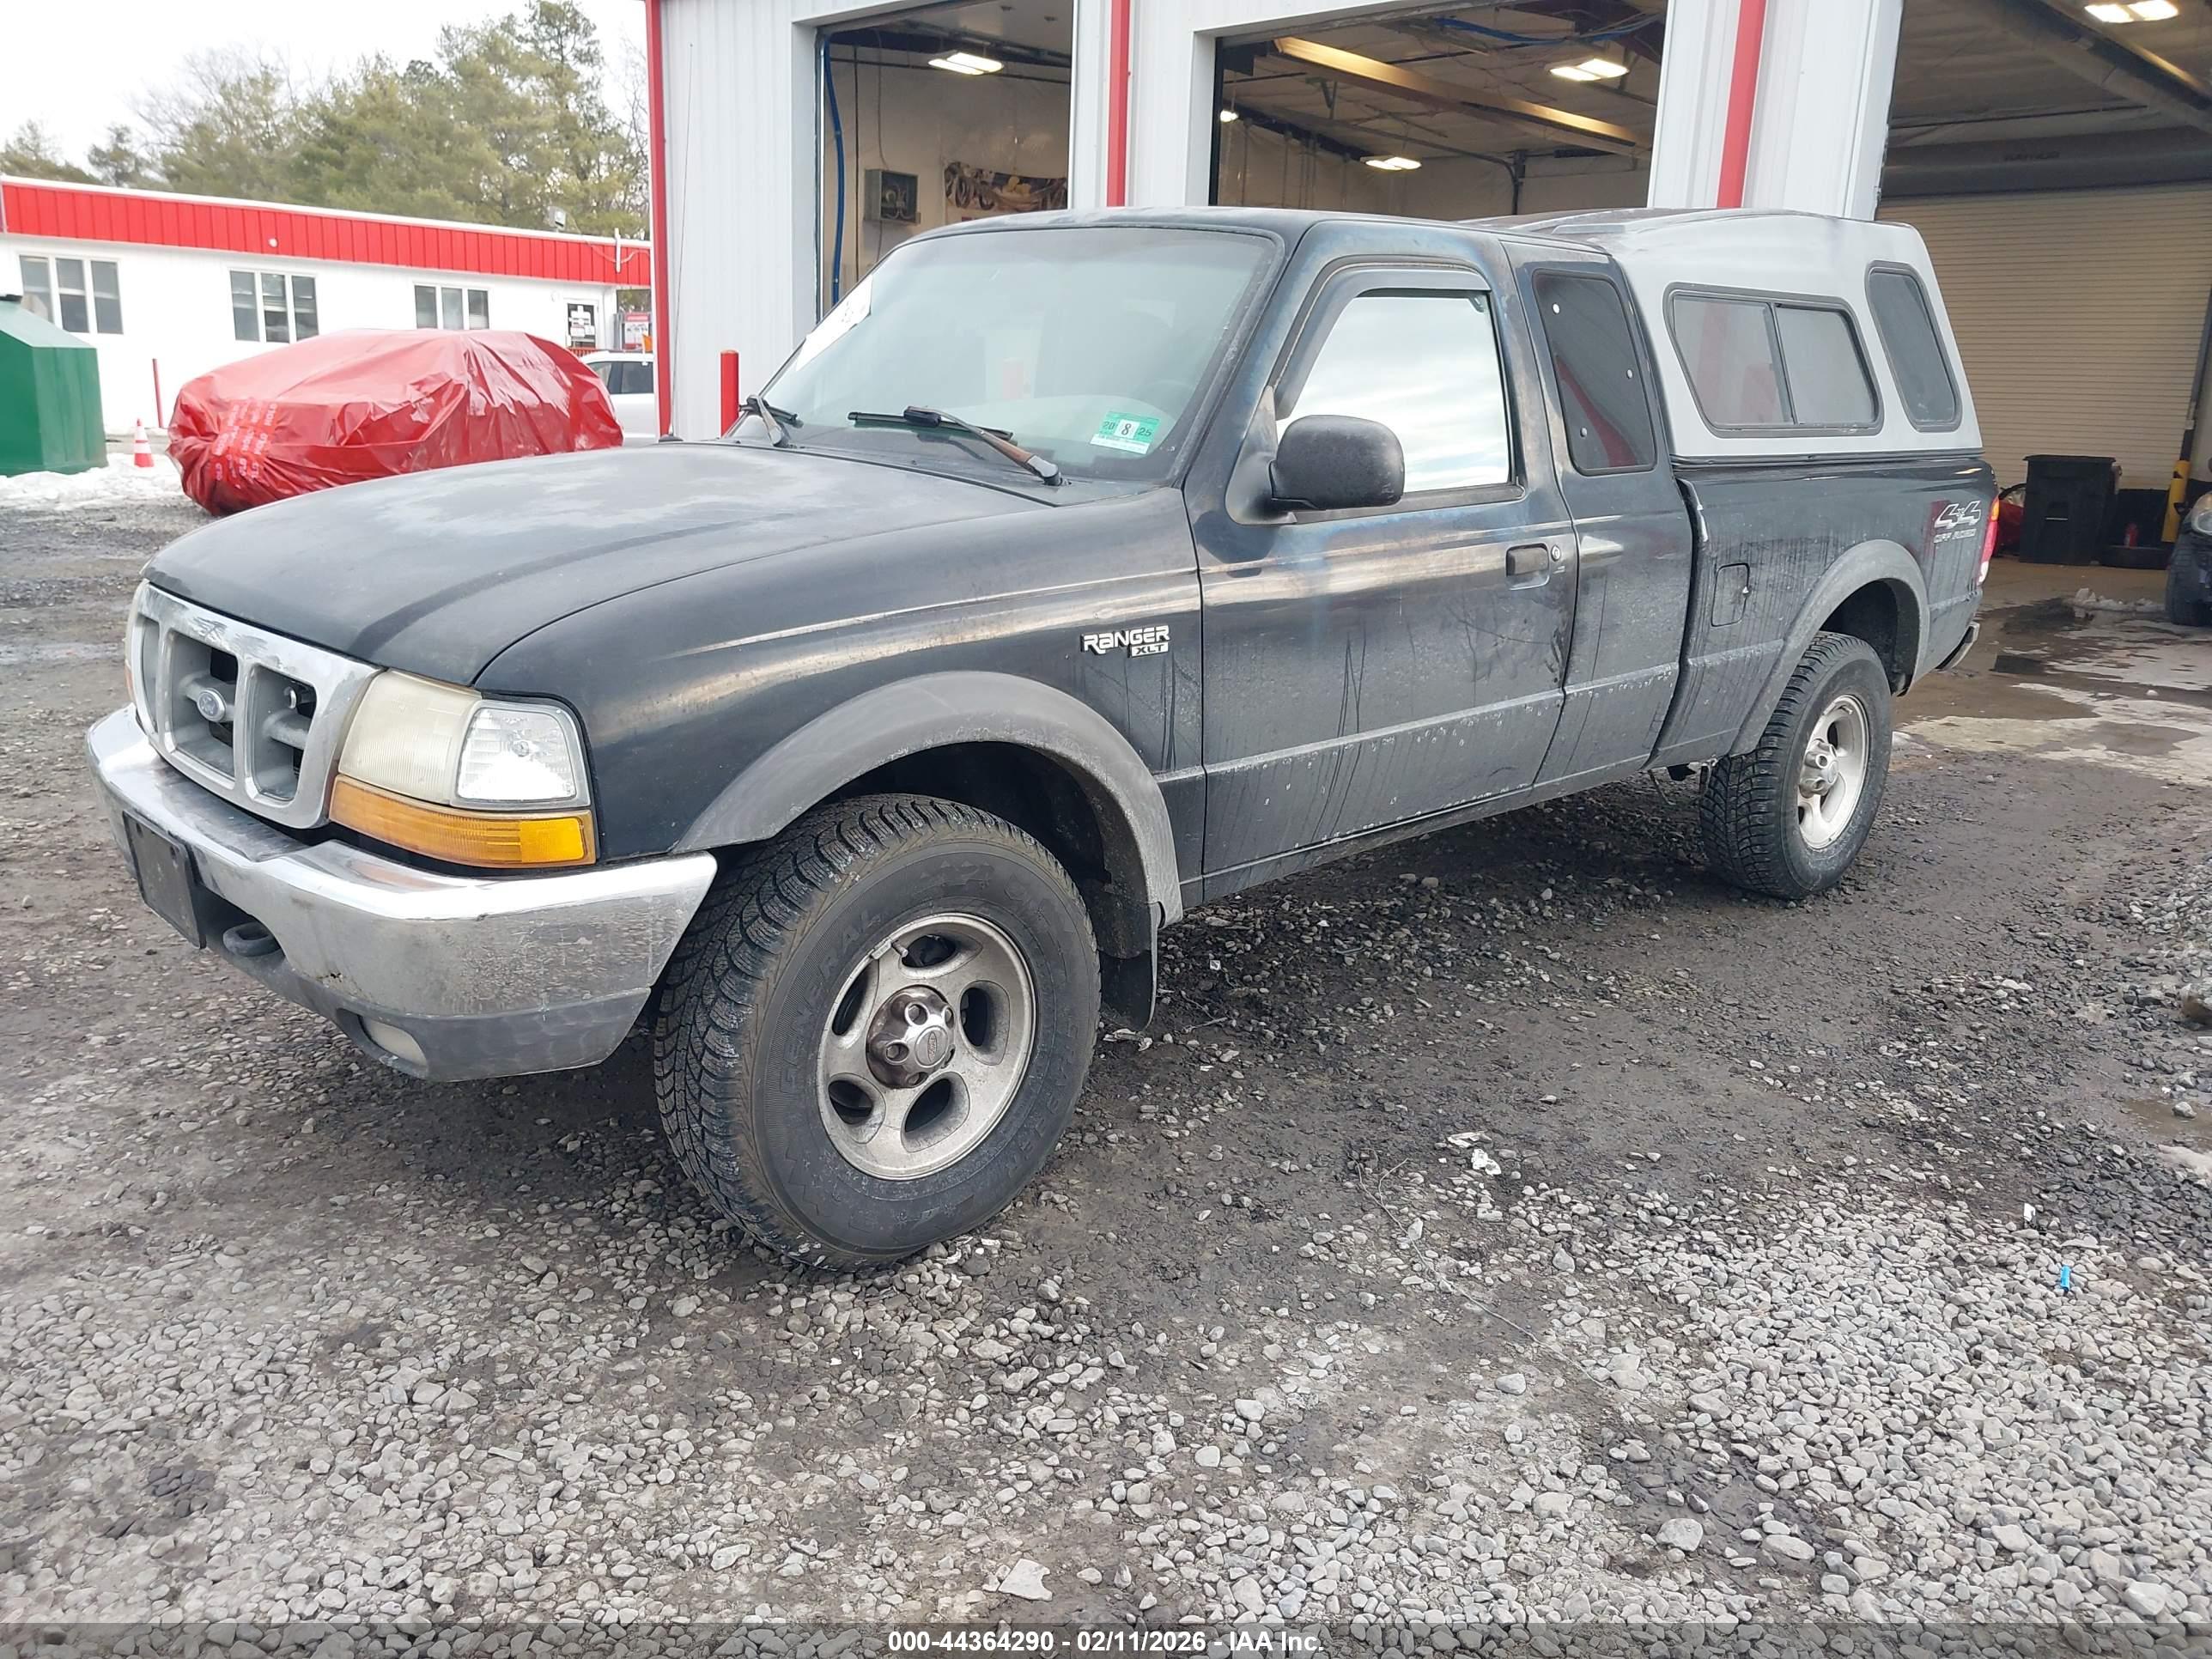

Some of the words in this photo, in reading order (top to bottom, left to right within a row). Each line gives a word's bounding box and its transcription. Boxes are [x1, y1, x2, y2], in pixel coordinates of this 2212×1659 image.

[264, 404, 277, 426] HOLD
[1121, 422, 1132, 436] 8
[1137, 427, 1152, 437] 25
[254, 433, 268, 455] HOLD
[1082, 625, 1170, 654] RANGER
[1135, 644, 1164, 654] XLT
